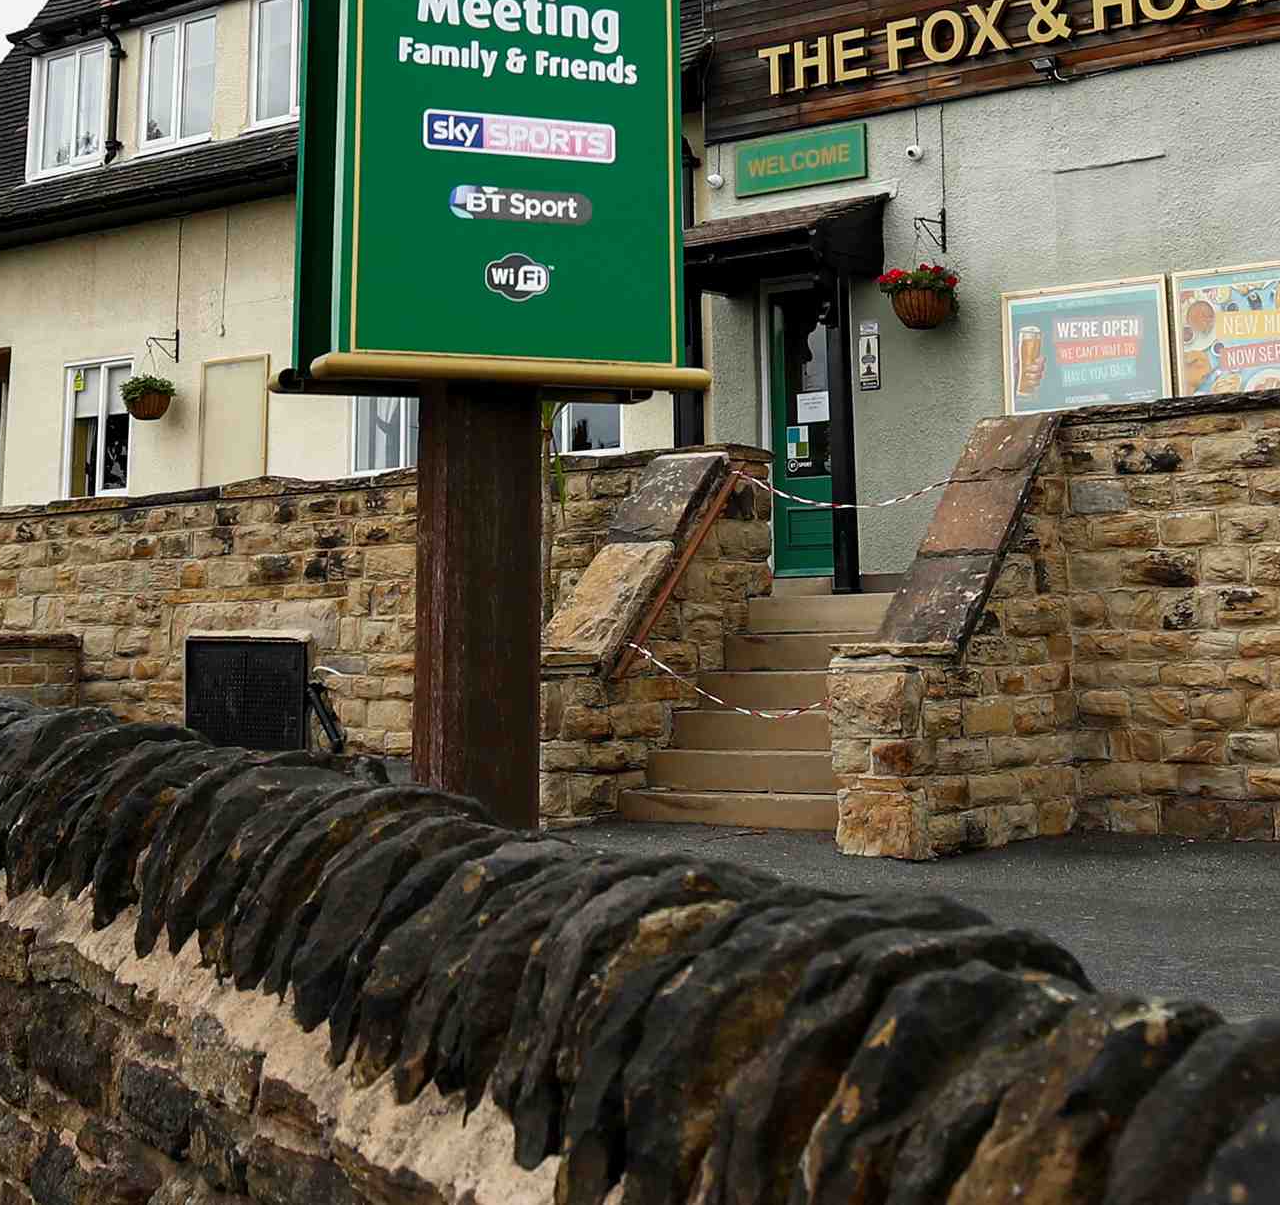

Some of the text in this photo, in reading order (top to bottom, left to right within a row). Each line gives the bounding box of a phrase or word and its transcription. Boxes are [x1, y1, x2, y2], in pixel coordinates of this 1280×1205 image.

[398, 36, 638, 85] Family & Friends
[758, 31, 868, 96] THE
[432, 115, 610, 158] sky SPORTS
[746, 143, 851, 178] WELCOME
[466, 186, 578, 220] BT Sport
[1056, 319, 1139, 339] WE'RE OPEN
[1223, 314, 1259, 334] NEW
[1227, 347, 1258, 366] NOW
